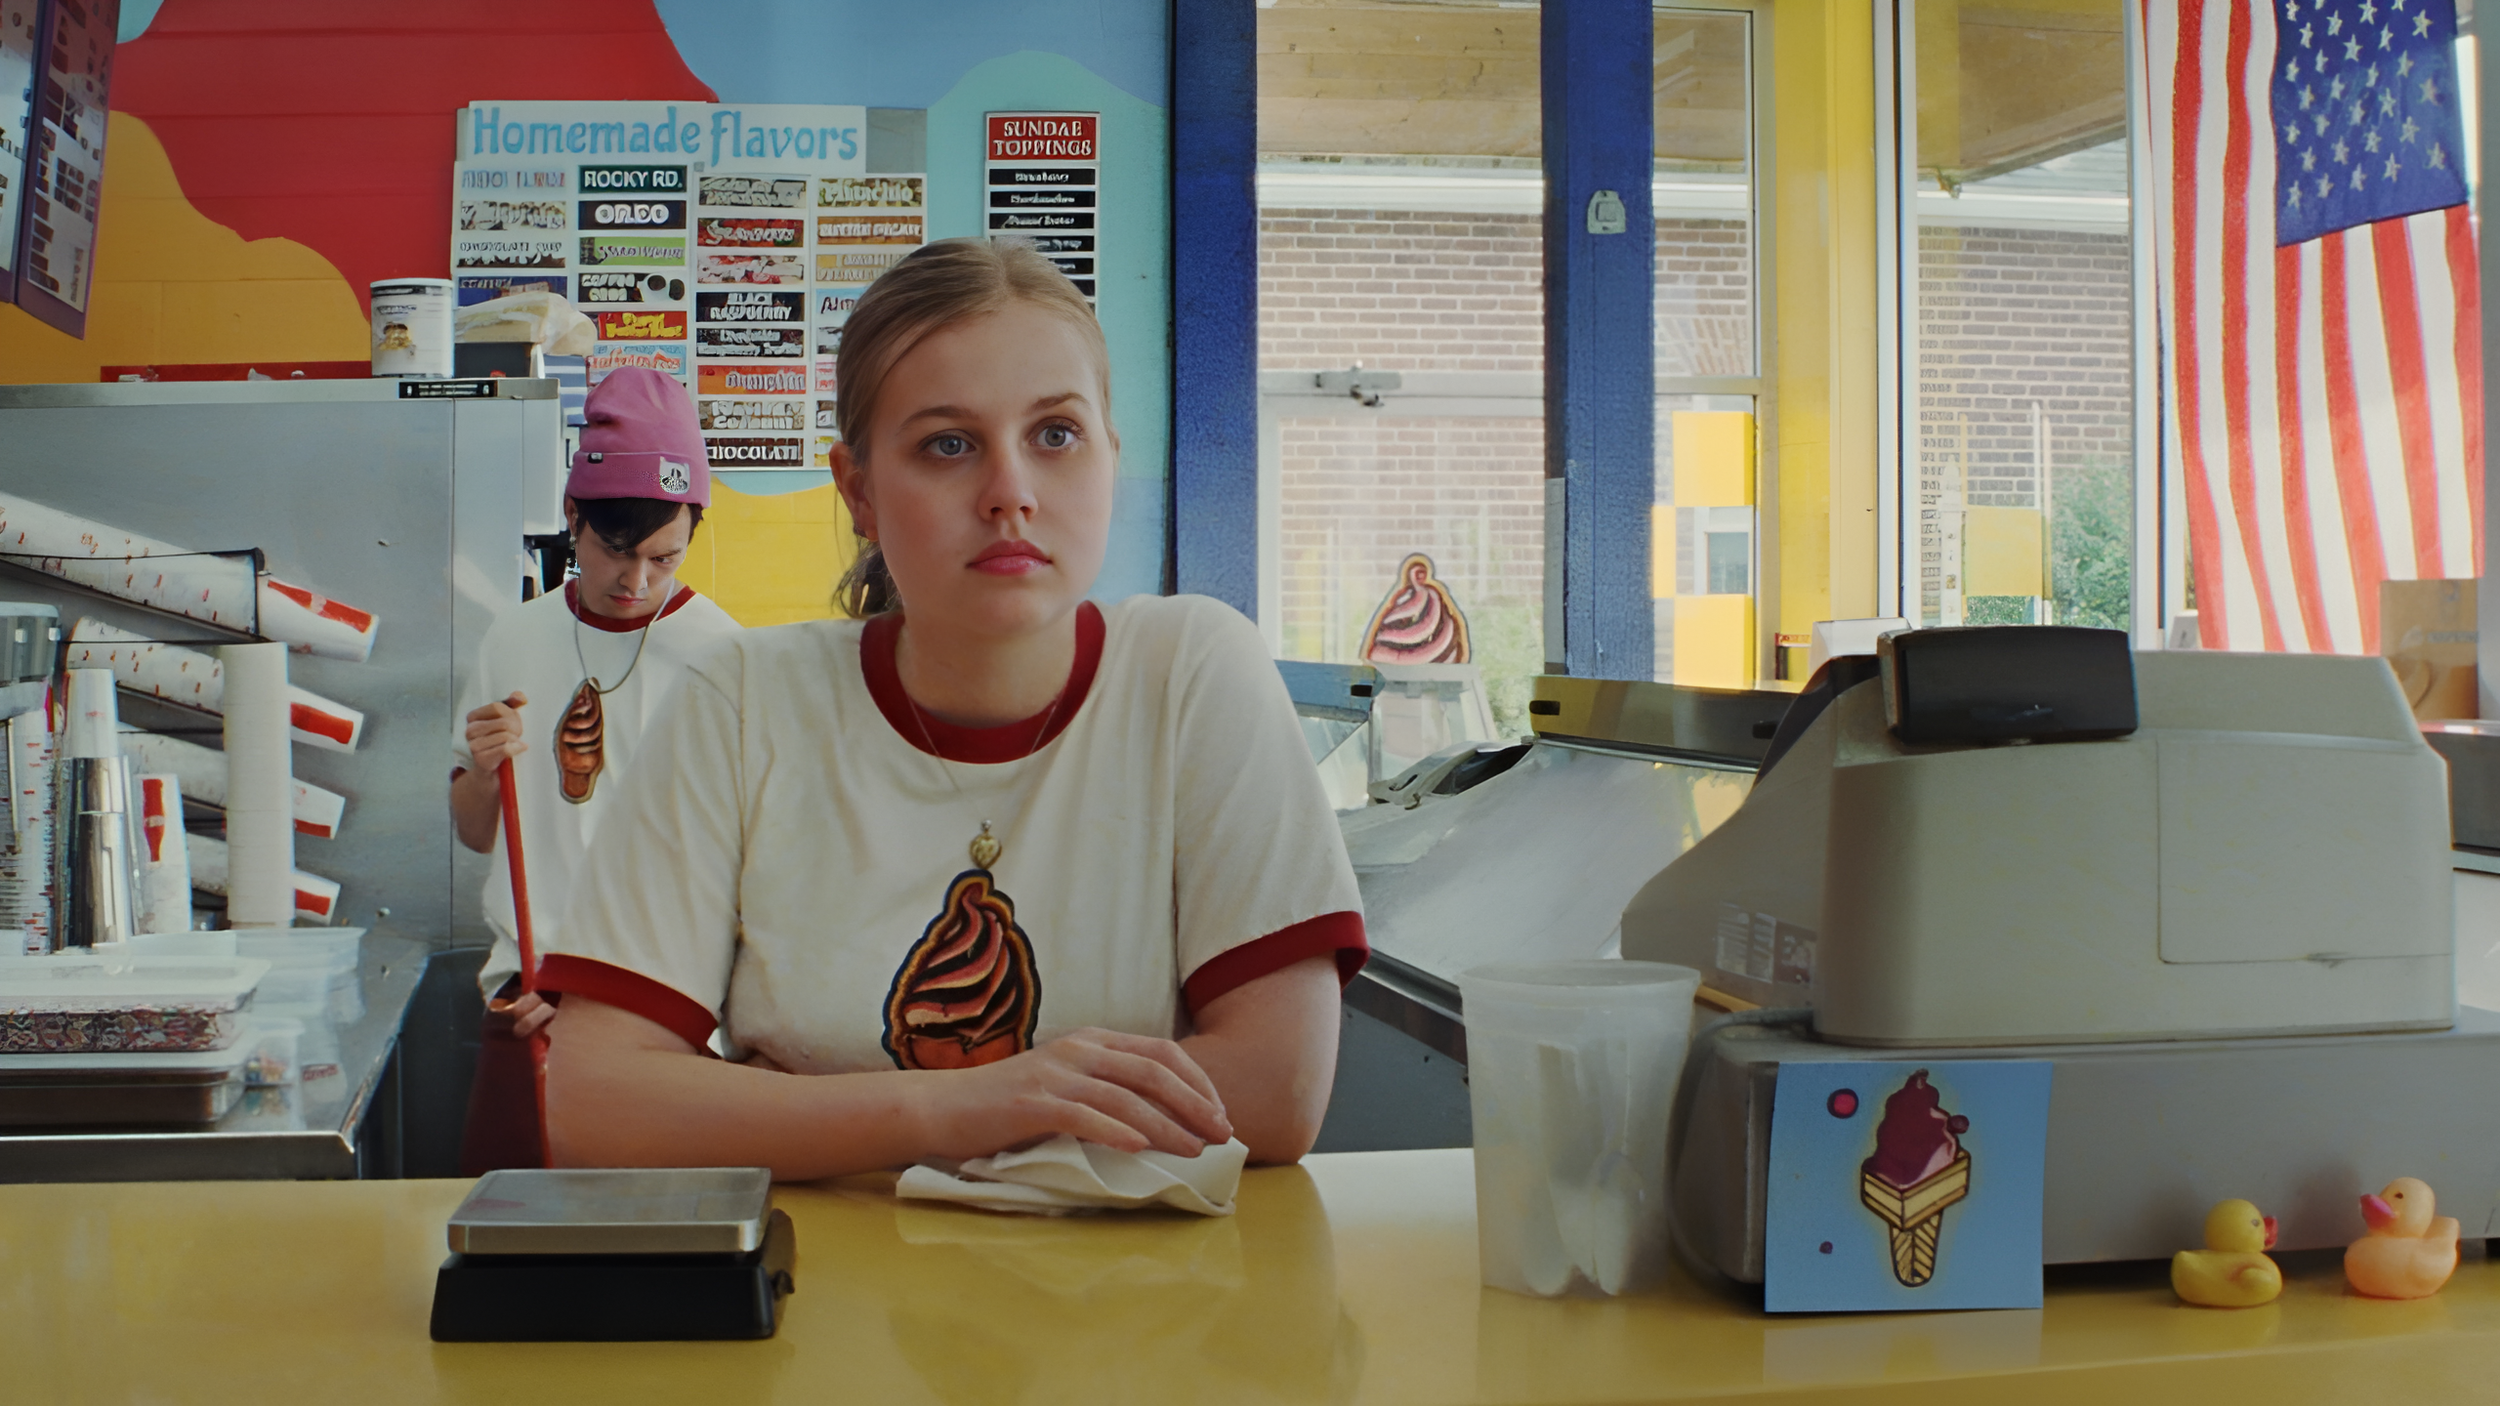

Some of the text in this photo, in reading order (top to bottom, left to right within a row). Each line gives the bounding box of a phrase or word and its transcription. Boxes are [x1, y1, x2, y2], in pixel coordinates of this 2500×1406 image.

[474, 105, 701, 155] Homemade
[993, 139, 1092, 156] TOPPINGS
[584, 170, 648, 188] ROCKY
